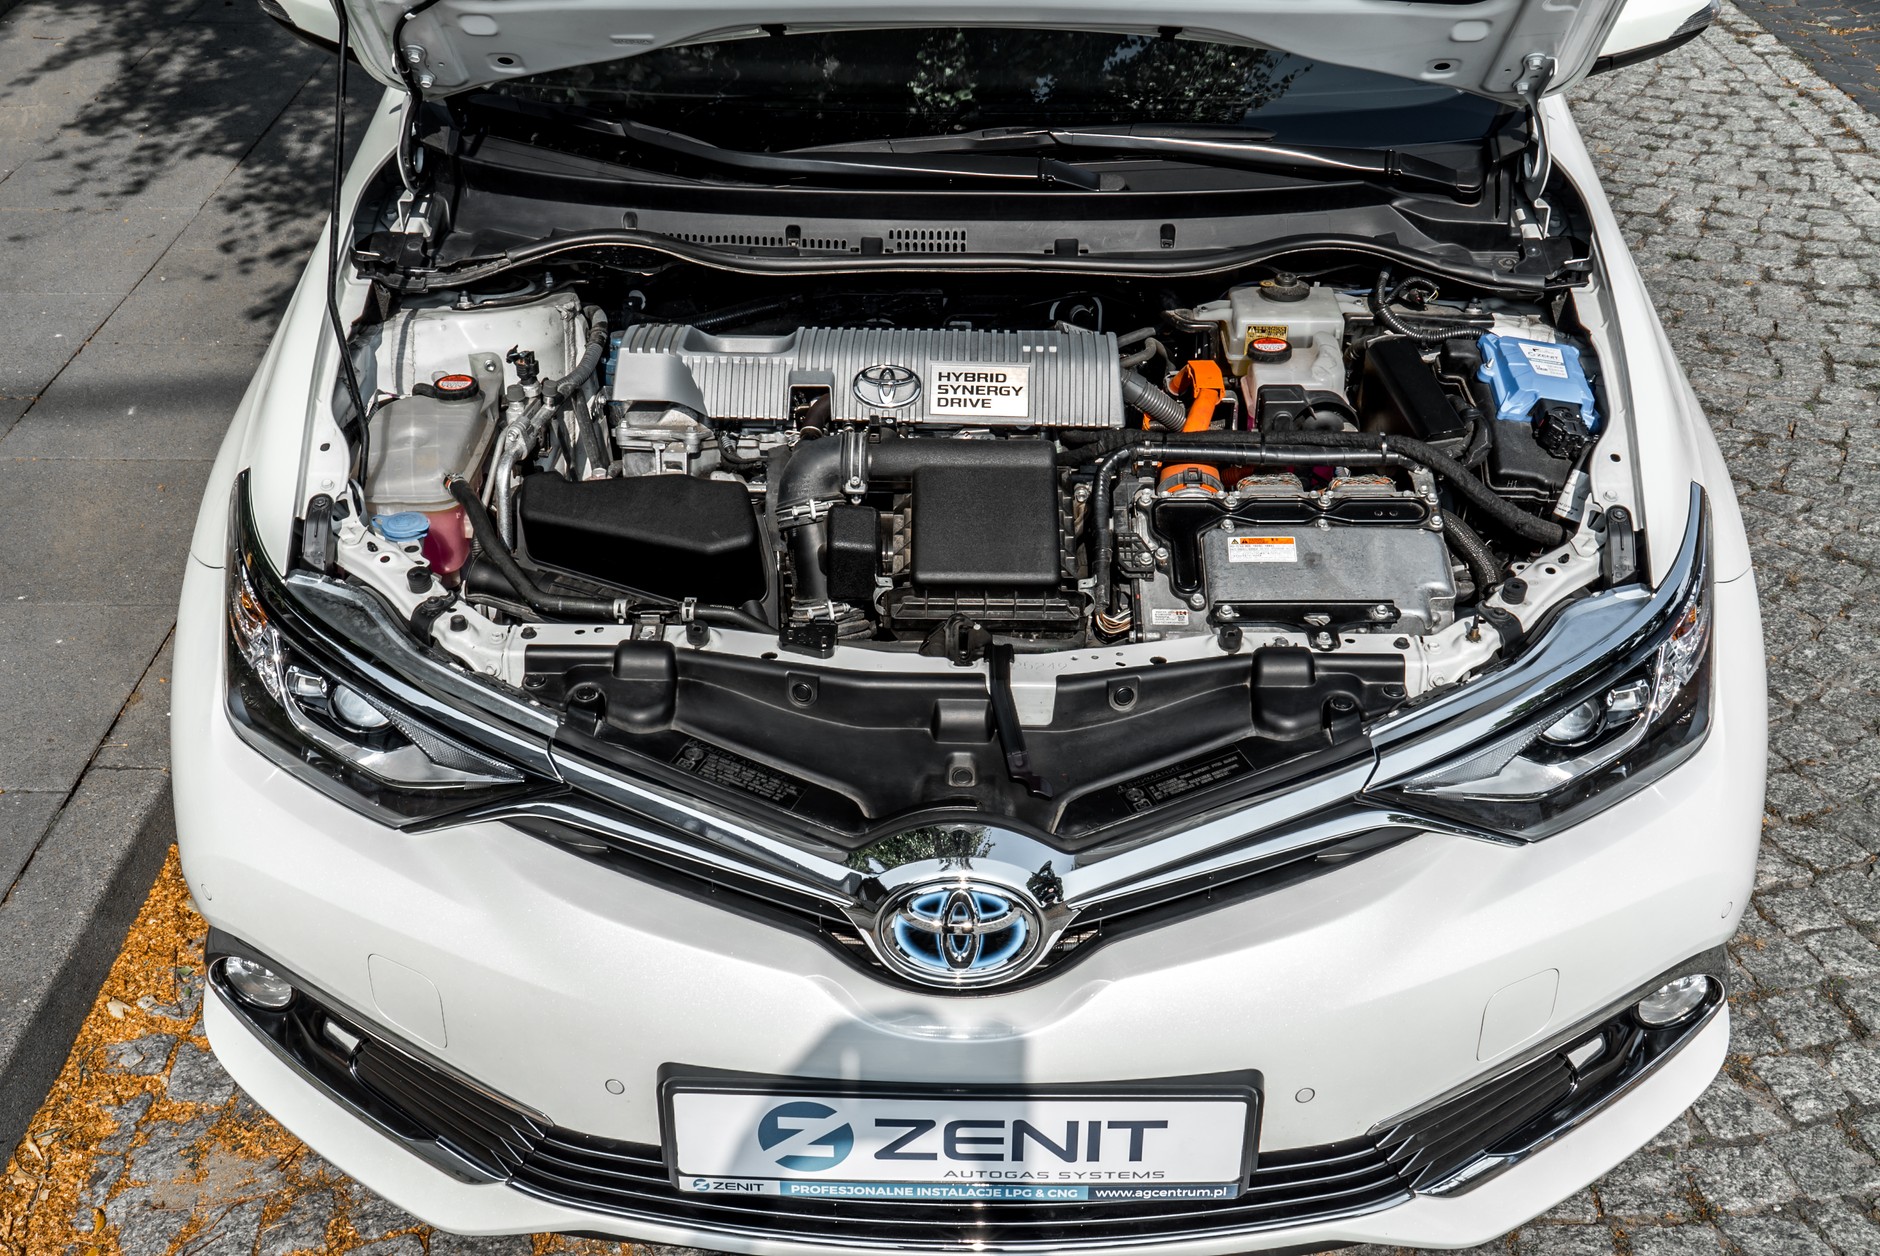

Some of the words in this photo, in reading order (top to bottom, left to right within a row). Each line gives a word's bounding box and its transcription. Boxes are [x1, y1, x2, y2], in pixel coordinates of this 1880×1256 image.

[938, 371, 1007, 383] HYBRID
[937, 385, 1024, 397] SYNERGY
[937, 397, 992, 409] DRIVE
[874, 1118, 1169, 1163] ZENIT
[944, 1170, 1050, 1180] AUTOGAS
[1058, 1170, 1165, 1180] SYSTEMS
[713, 1181, 764, 1192] ZENIT
[790, 1184, 914, 1197] PROFESJONALNE
[916, 1187, 1002, 1198] INSTALACJE
[1005, 1188, 1032, 1198] LPG
[1035, 1189, 1044, 1198] &
[1047, 1189, 1078, 1199] CNG
[1095, 1186, 1228, 1199] www.agcentrum.pl
